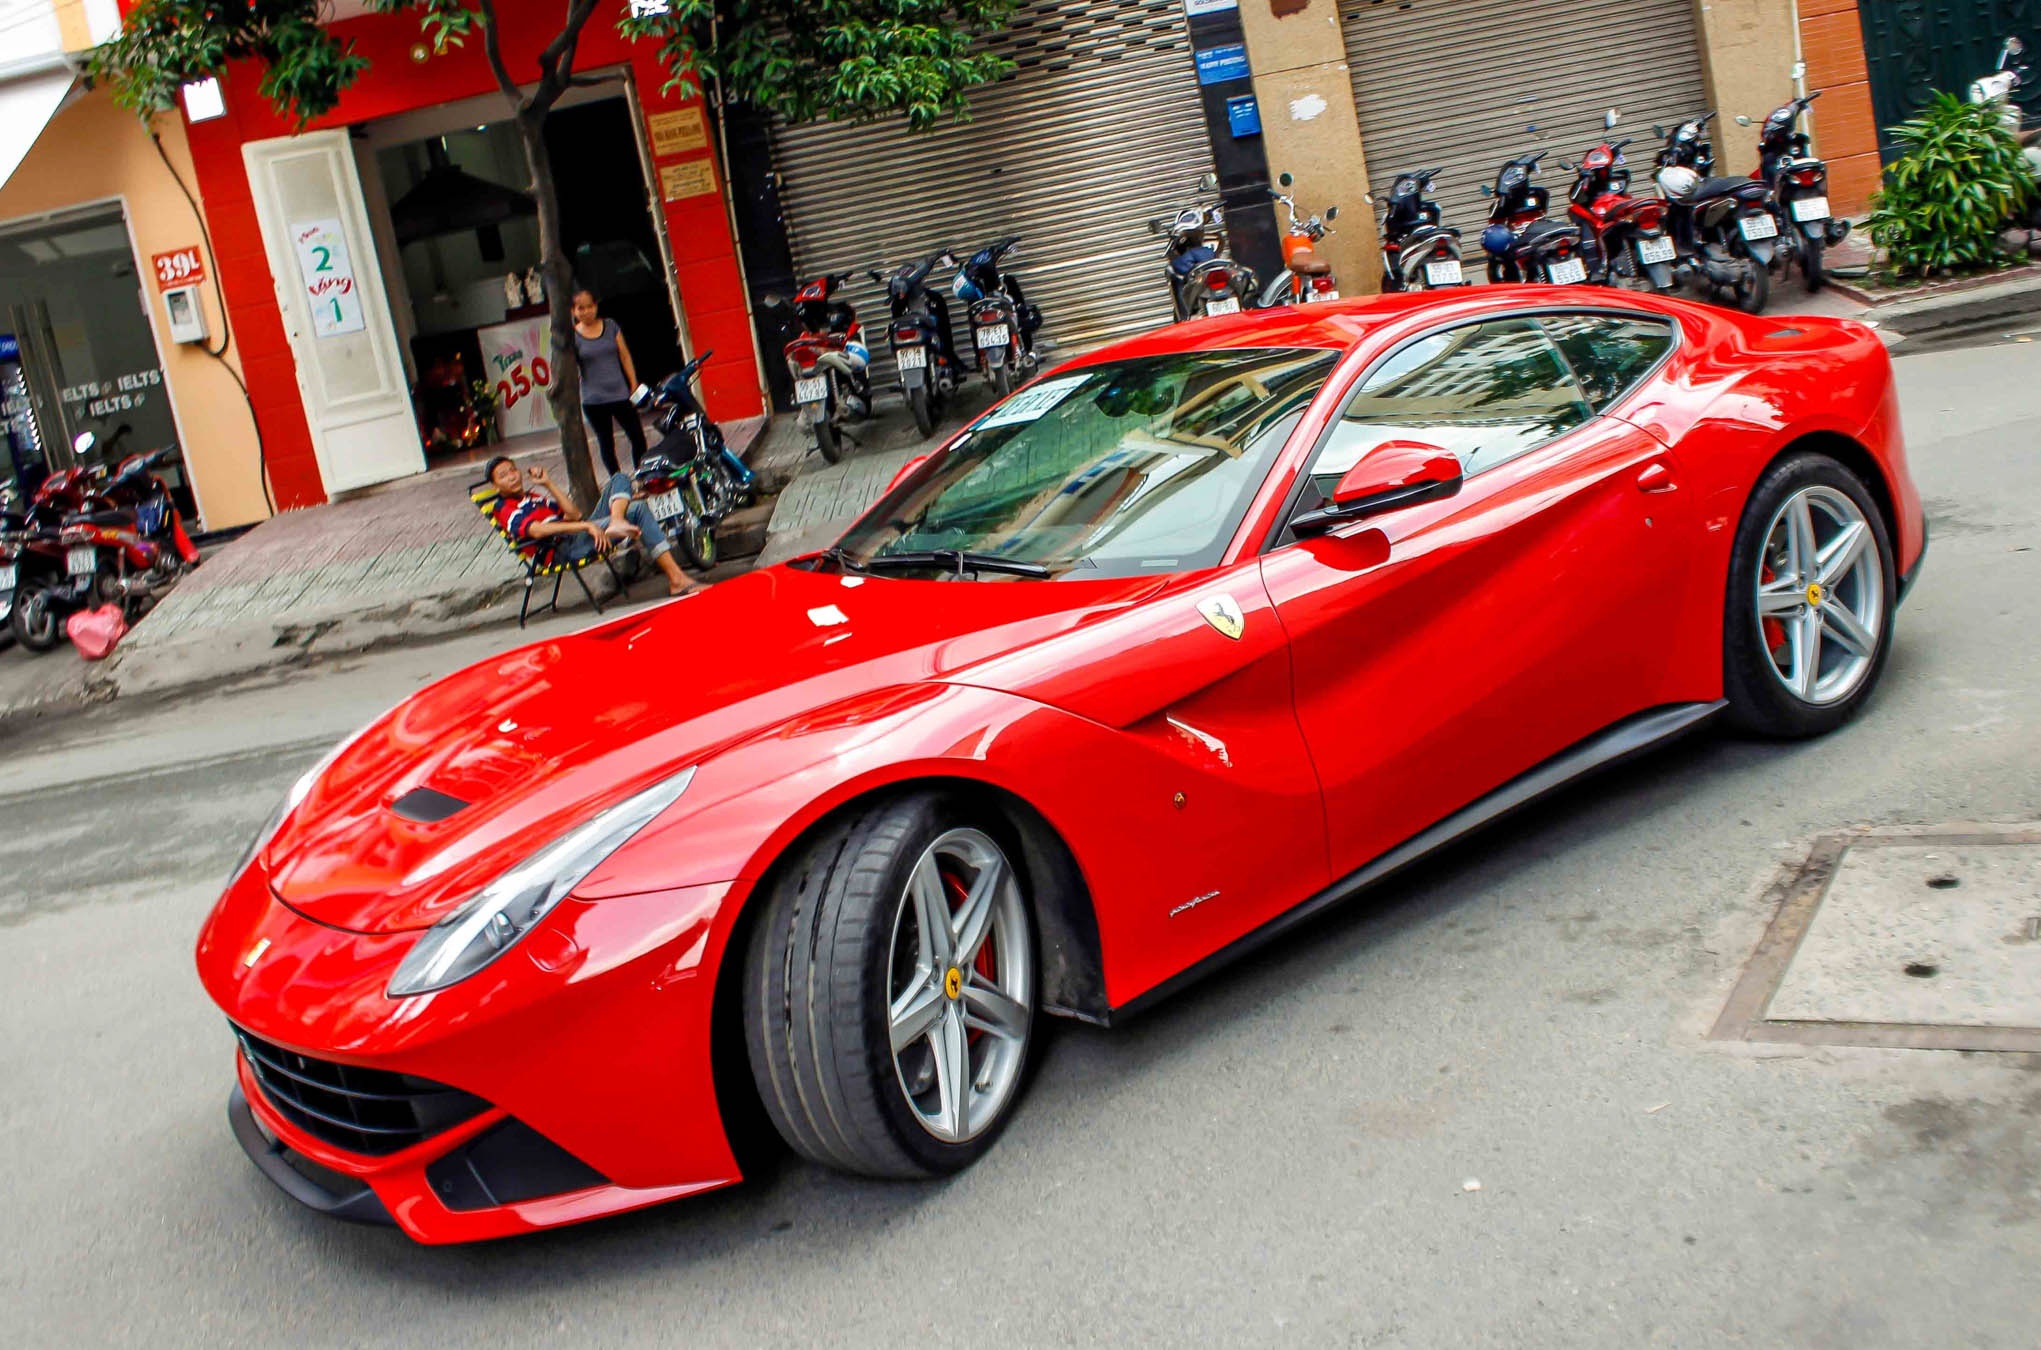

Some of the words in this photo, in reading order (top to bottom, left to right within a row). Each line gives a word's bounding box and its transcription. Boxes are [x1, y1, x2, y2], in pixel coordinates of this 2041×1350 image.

[157, 250, 200, 280] 39L
[312, 246, 333, 272] 2
[330, 297, 342, 322] 1
[62, 382, 100, 402] ELTS
[117, 369, 161, 391] IELTS
[90, 395, 132, 416] IELTS
